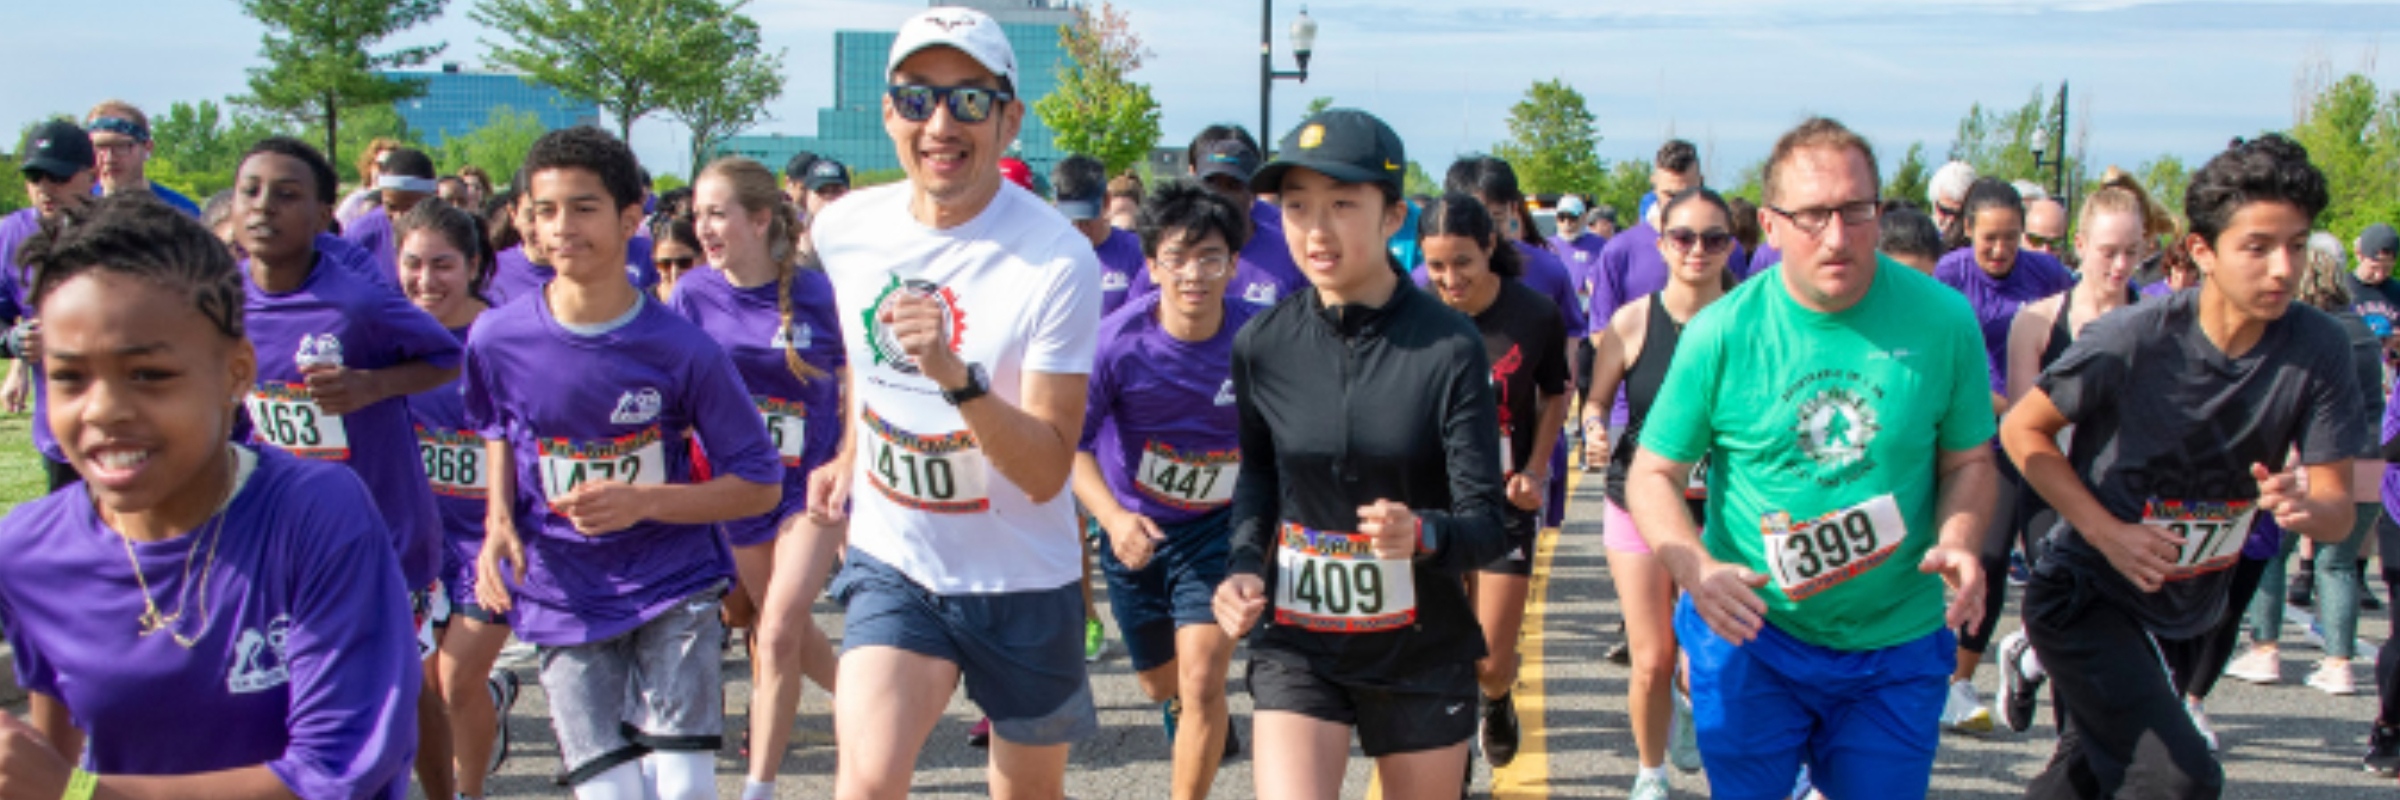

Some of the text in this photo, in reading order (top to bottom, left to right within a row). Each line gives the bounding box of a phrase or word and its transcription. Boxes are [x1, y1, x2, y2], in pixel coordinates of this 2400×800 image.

[421, 445, 475, 484] 368
[878, 443, 955, 500] 410
[1156, 463, 1221, 499] 447
[1787, 510, 1876, 578] 399
[1296, 559, 1383, 614] 409
